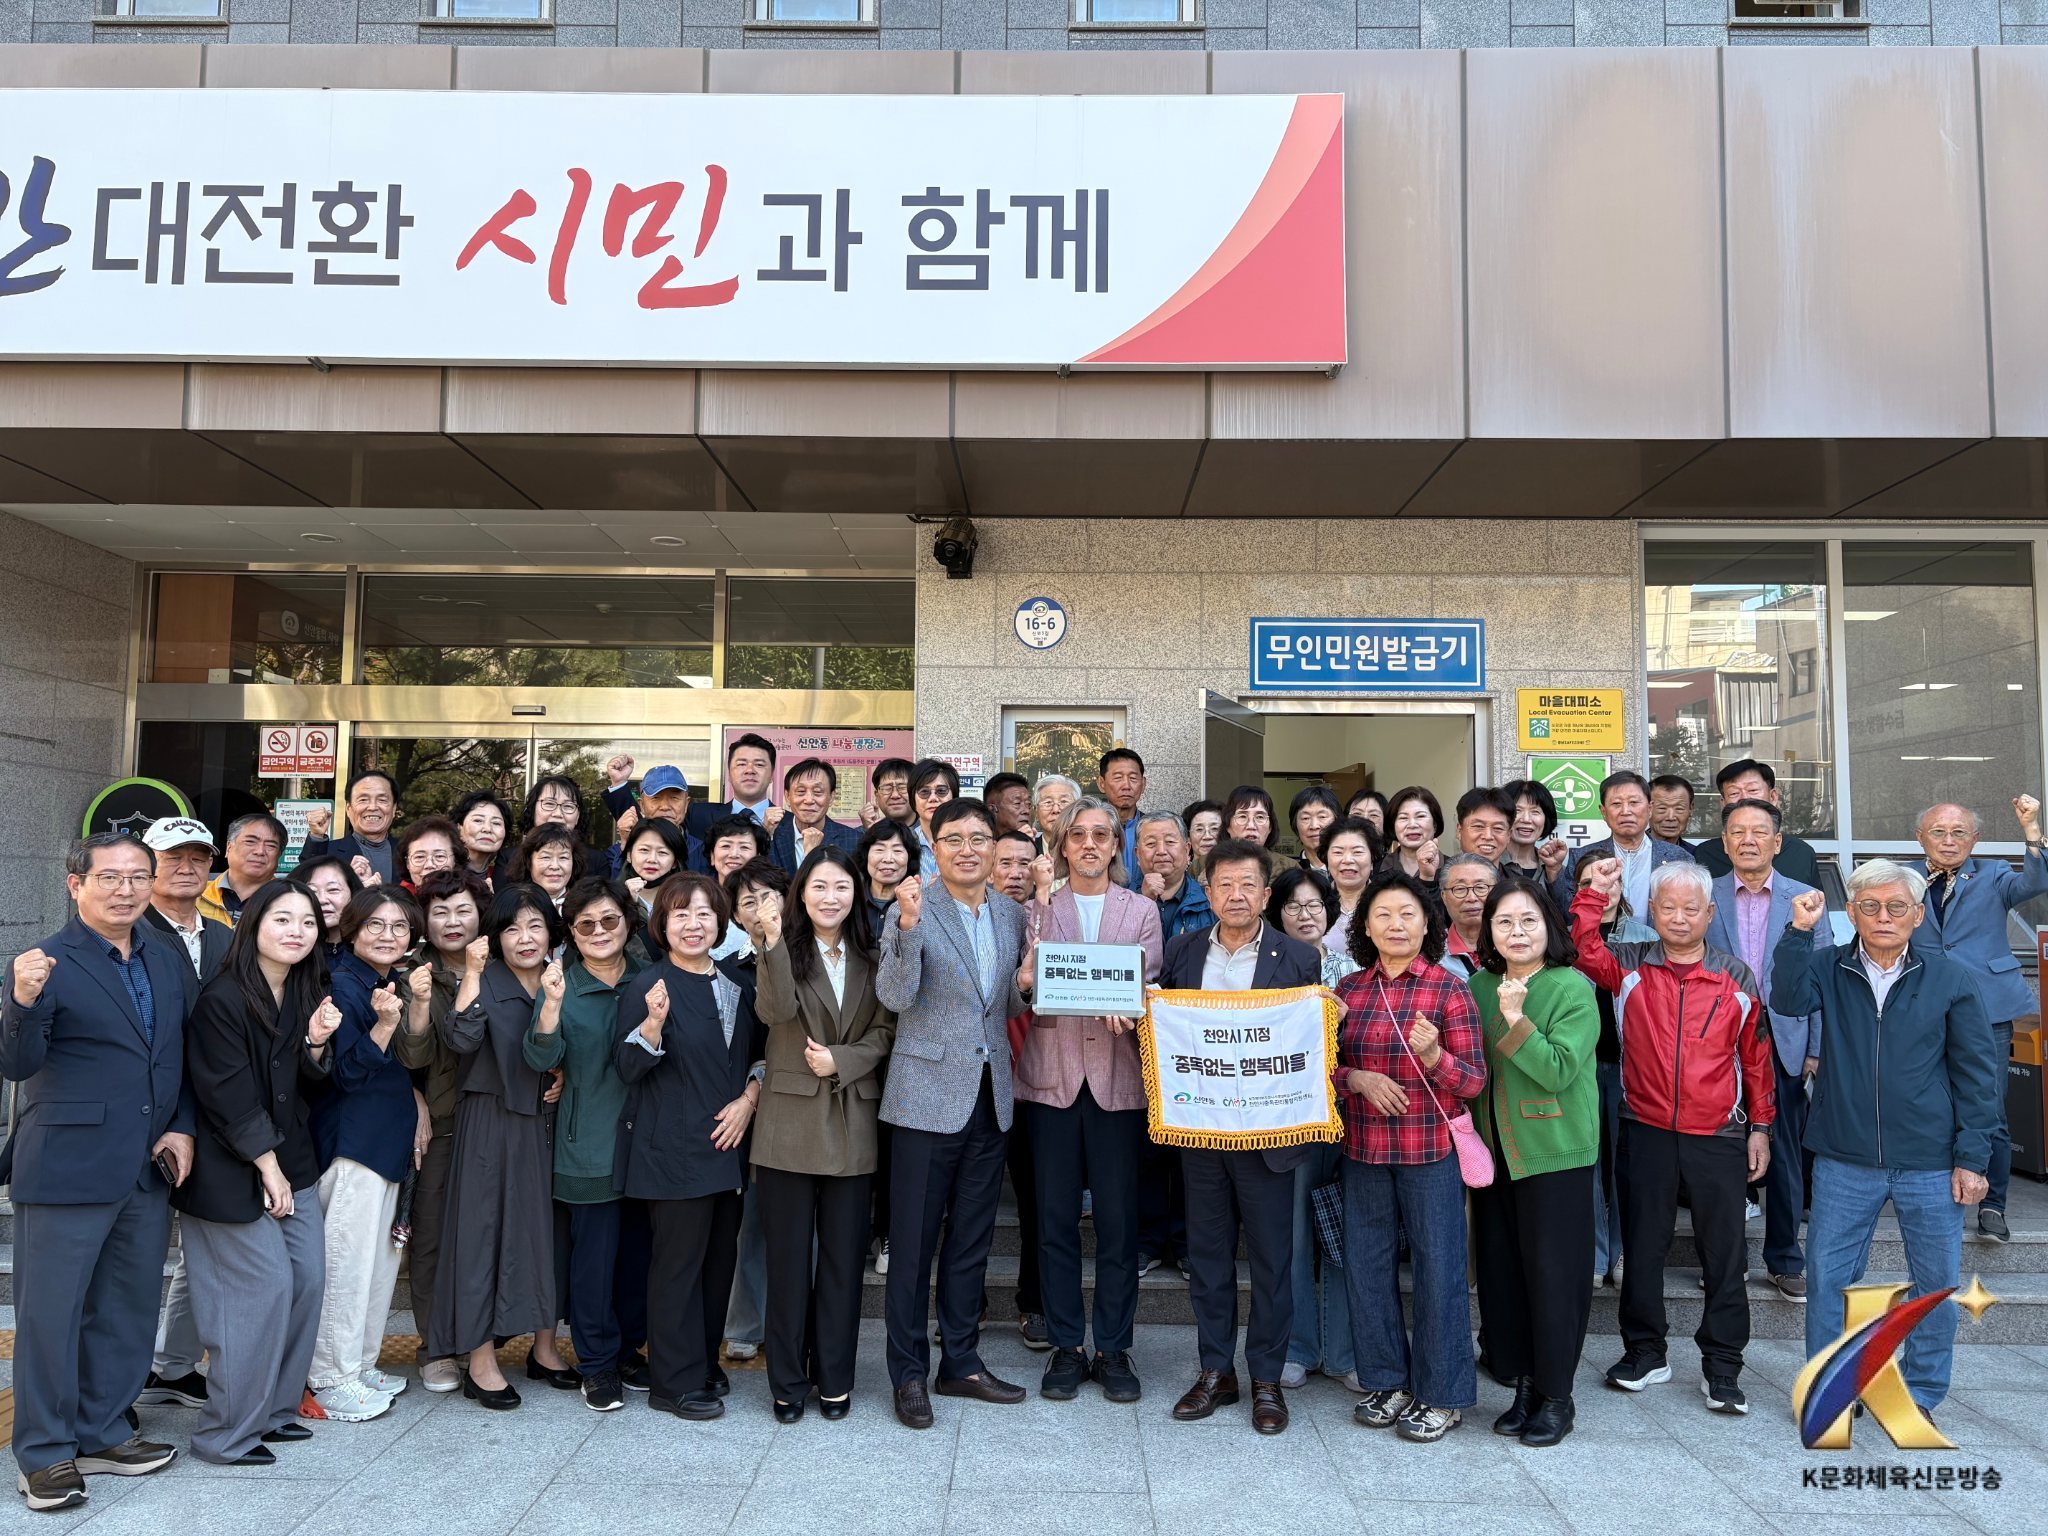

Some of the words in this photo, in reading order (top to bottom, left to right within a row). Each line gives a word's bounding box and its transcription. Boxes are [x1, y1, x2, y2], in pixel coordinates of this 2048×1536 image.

[92, 180, 415, 286] 대전환
[902, 186, 1109, 293] 함께
[1025, 617, 1056, 630] 16-6
[1266, 634, 1467, 672] 무인민원발급기
[1539, 695, 1602, 707] 마을대피소
[798, 737, 829, 750] 신안동
[262, 757, 295, 766] 금연구역
[299, 757, 332, 767] 금주구역
[163, 819, 207, 833] Callaway
[1045, 954, 1069, 963] 천안시
[1070, 954, 1087, 964] 지정
[1045, 967, 1088, 980] 중독없는
[1090, 968, 1135, 981] 행복마을
[1203, 1028, 1242, 1044] 천안시
[1244, 1027, 1271, 1043] 지정
[1193, 1095, 1216, 1106] 신안동
